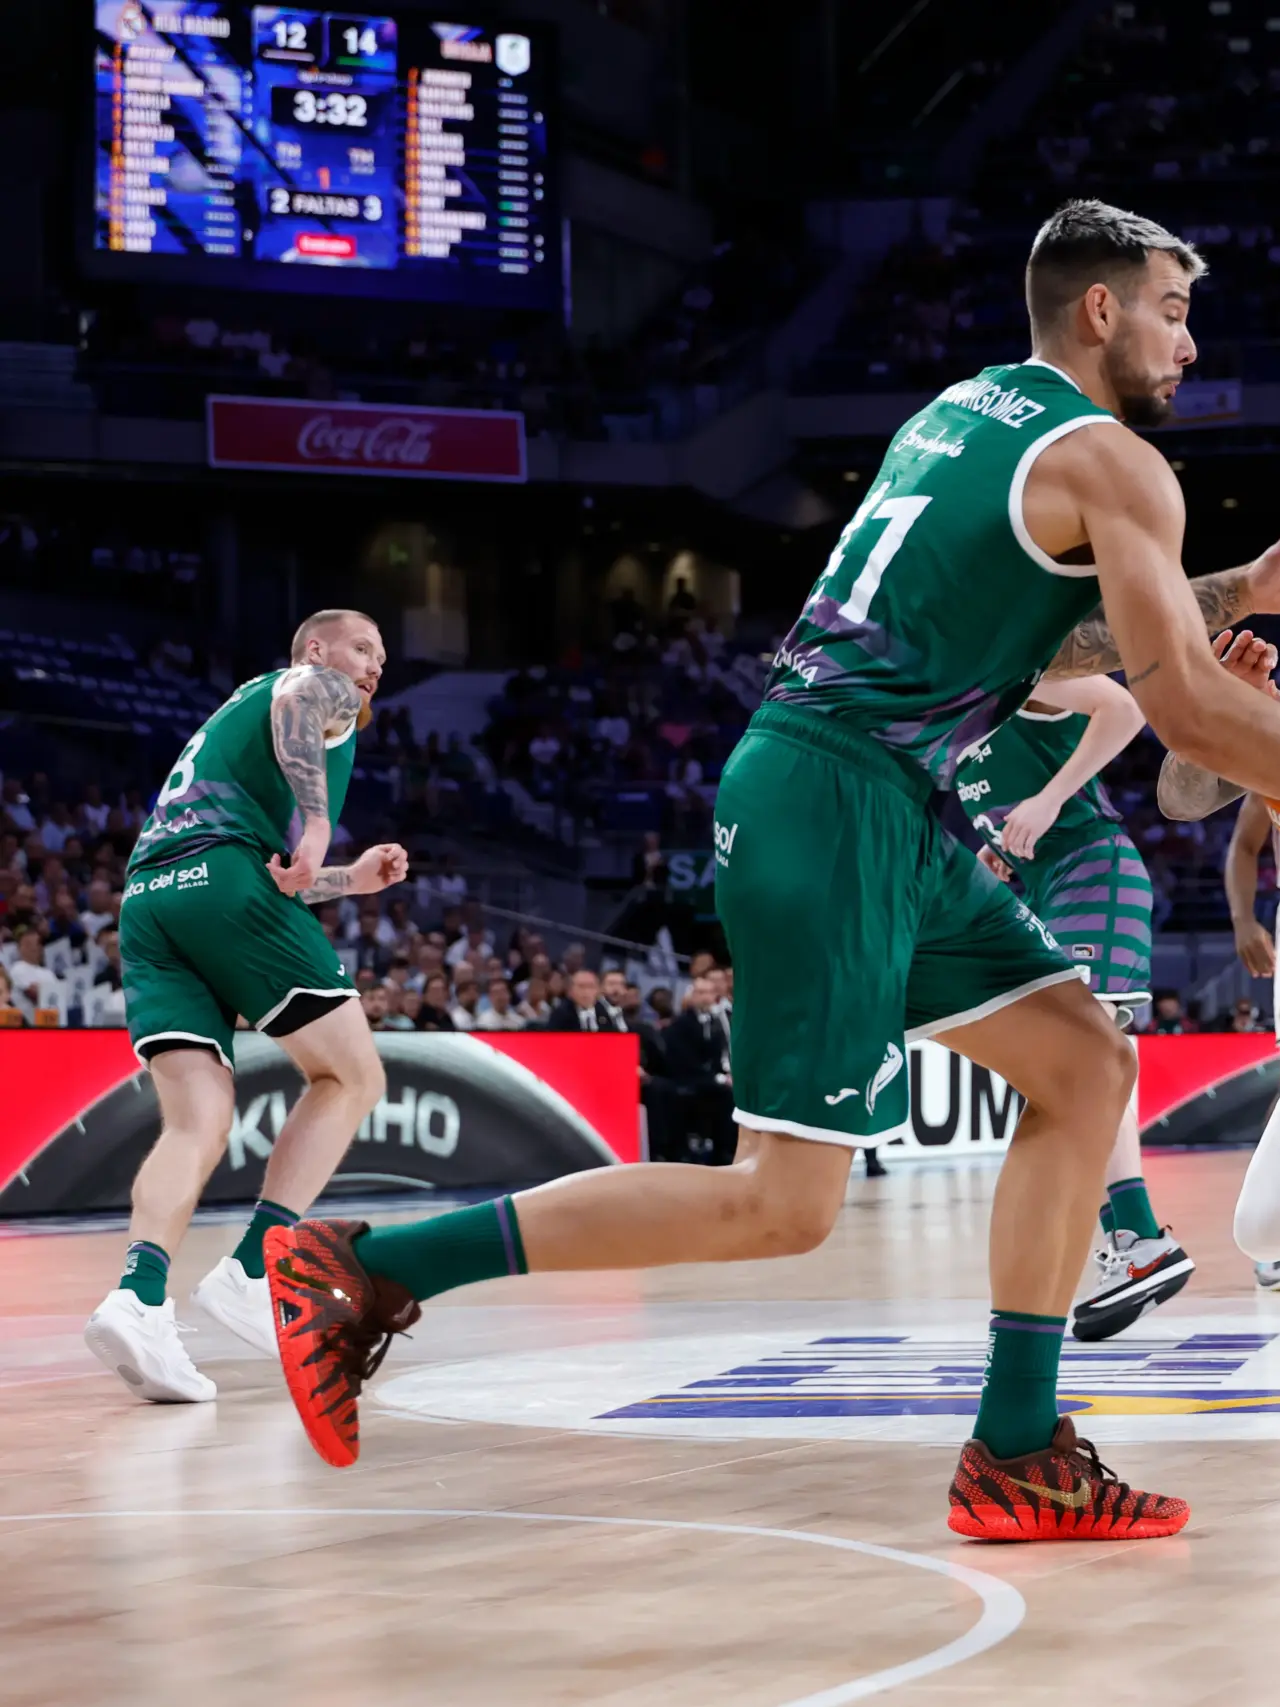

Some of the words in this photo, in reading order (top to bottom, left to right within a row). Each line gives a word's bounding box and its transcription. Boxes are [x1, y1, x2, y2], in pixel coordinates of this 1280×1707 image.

[272, 21, 307, 49] 12
[343, 27, 377, 56] 14
[293, 91, 367, 127] 3:32
[271, 188, 290, 214] 2
[292, 194, 359, 218] FALTAS
[363, 195, 382, 221] 3
[149, 870, 175, 891] del
[177, 862, 208, 883] sol
